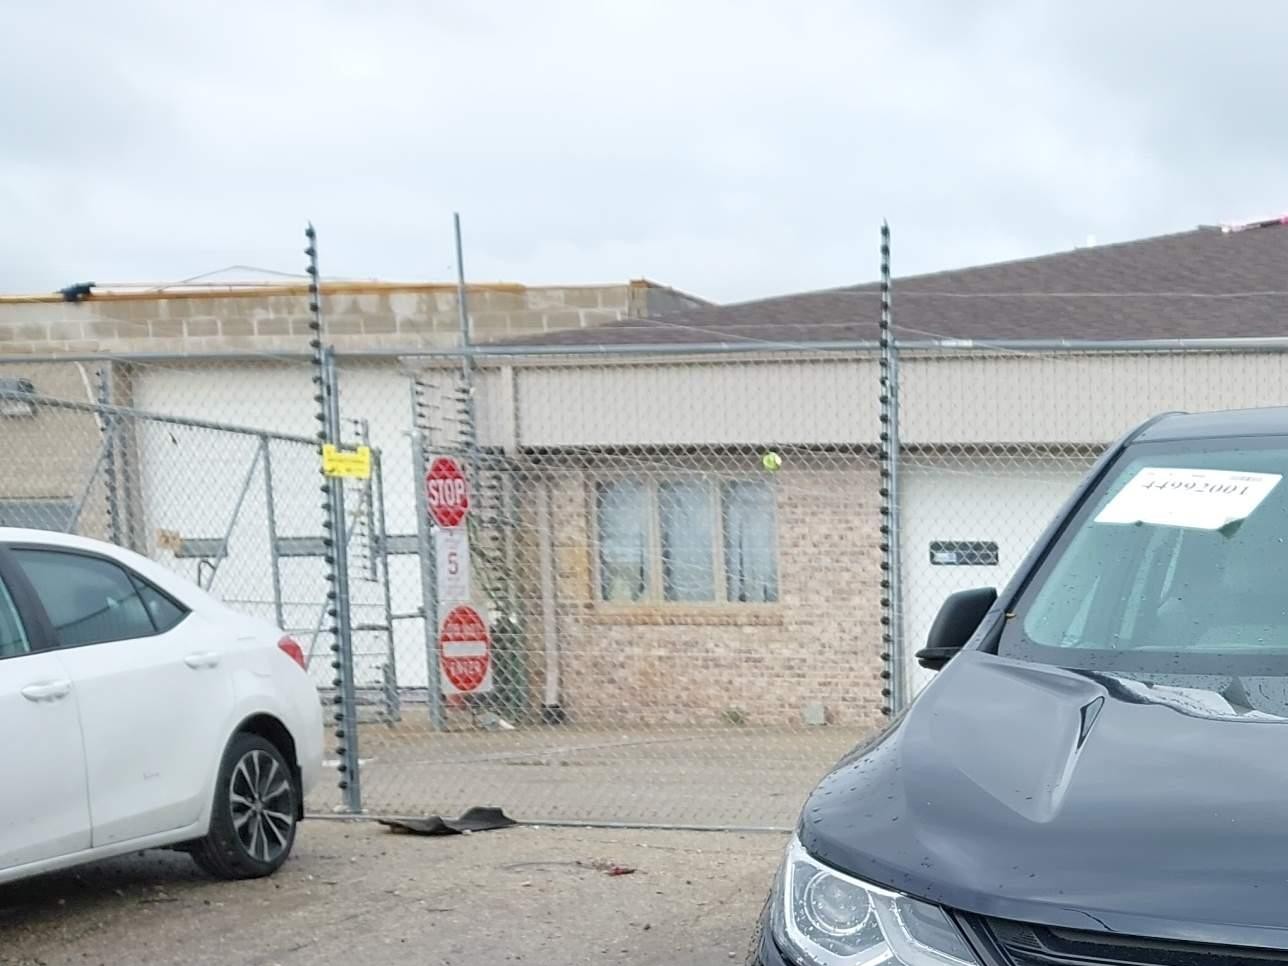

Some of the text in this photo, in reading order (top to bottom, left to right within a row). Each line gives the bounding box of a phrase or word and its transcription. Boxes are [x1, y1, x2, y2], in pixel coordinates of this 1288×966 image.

[429, 478, 465, 507] STOP
[1141, 481, 1249, 496] 44992001
[447, 552, 459, 575] 5
